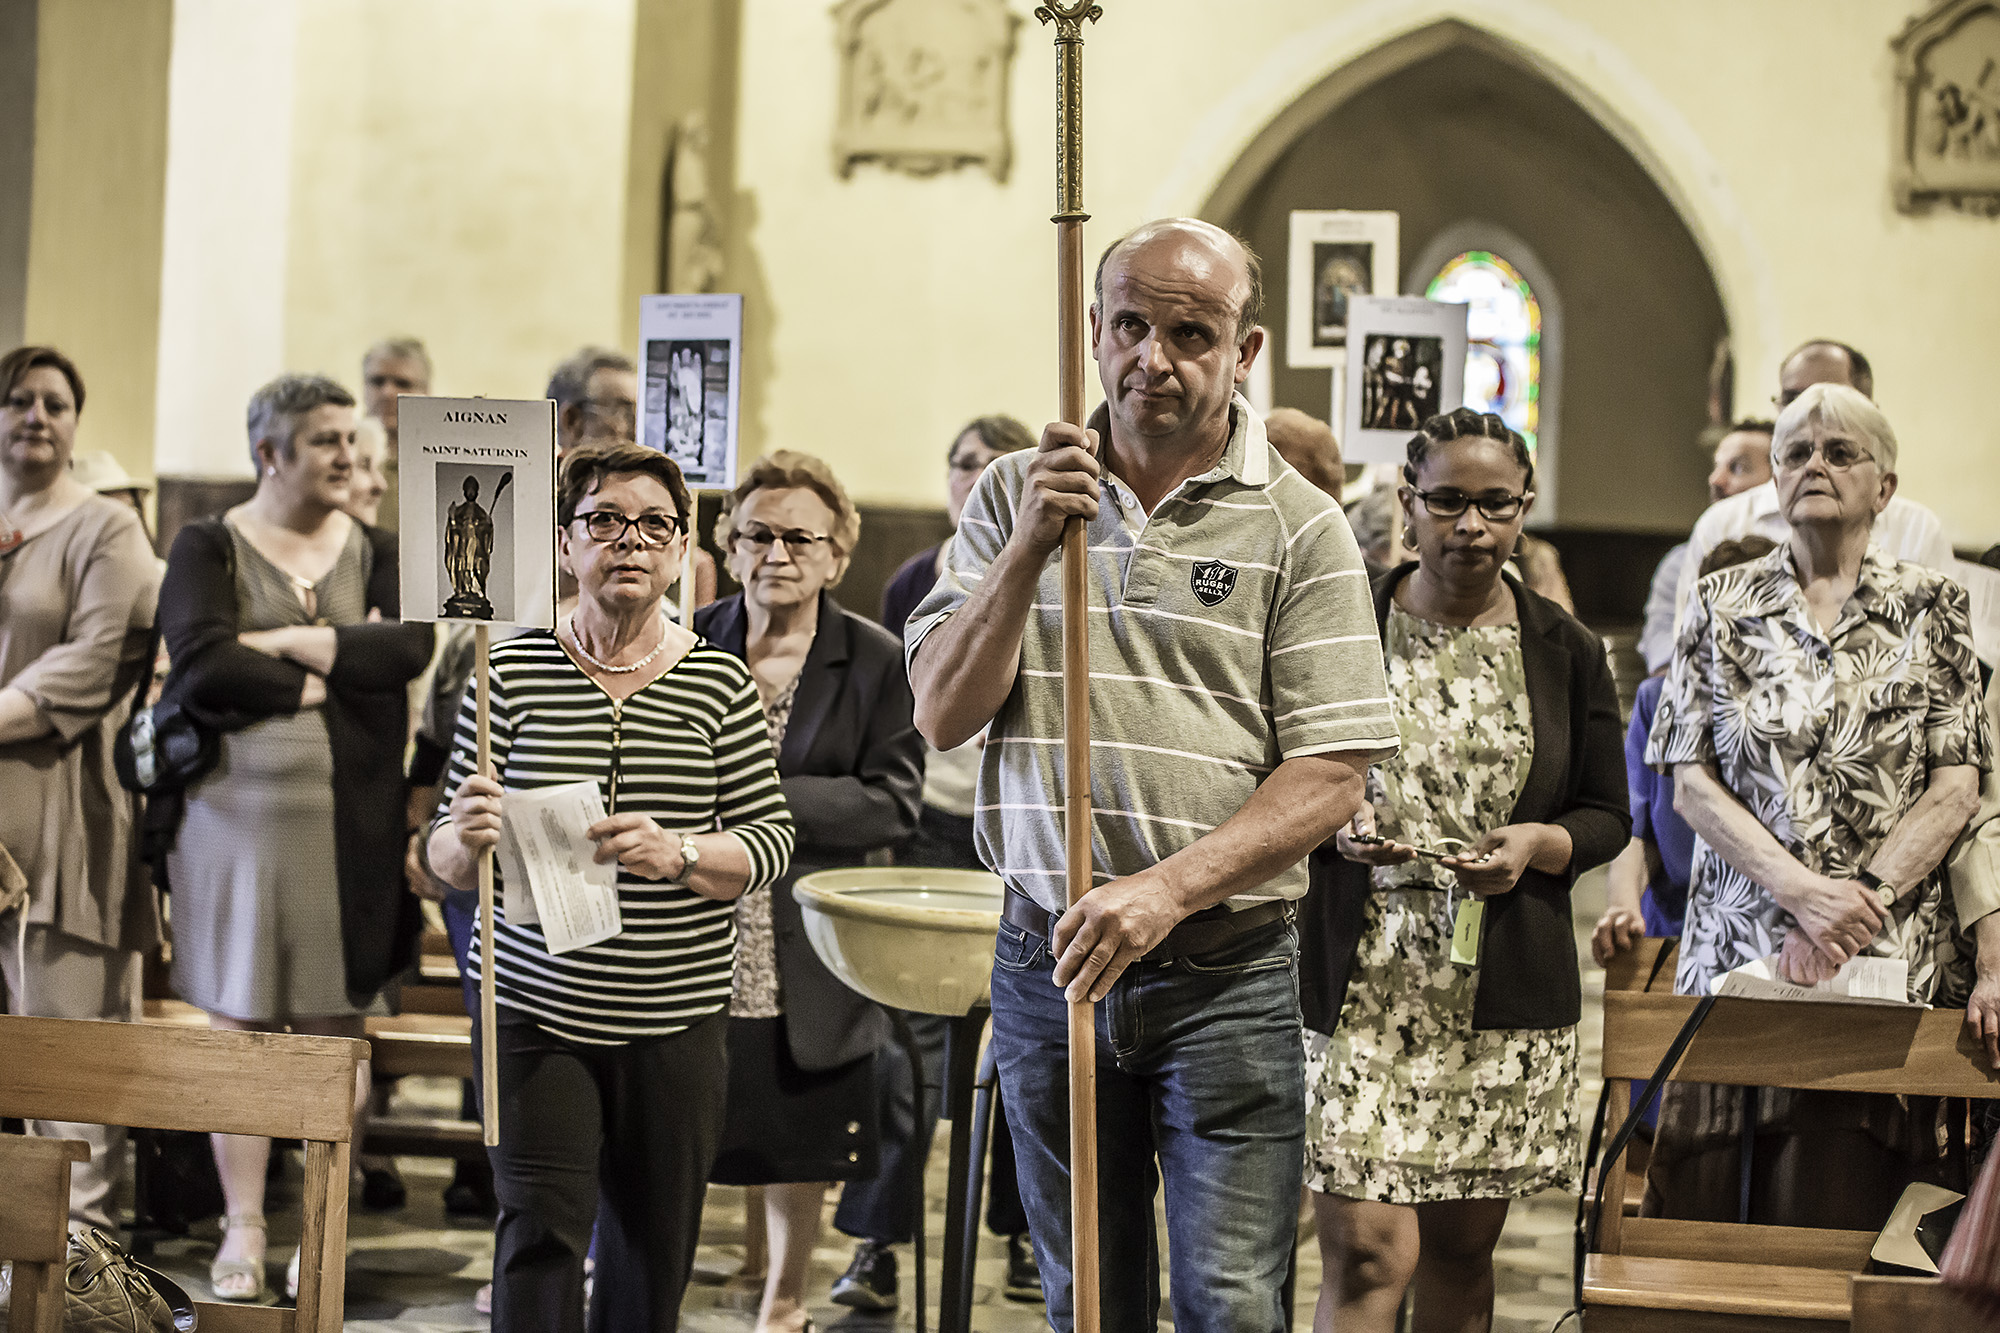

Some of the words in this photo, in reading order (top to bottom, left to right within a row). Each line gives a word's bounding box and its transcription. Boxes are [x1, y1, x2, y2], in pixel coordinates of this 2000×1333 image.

[443, 411, 507, 424] AIGNAN
[422, 445, 461, 455] SAINT
[463, 448, 528, 458] SATURNIN
[1195, 579, 1231, 592] RUGBY
[1198, 587, 1223, 596] SELLA
